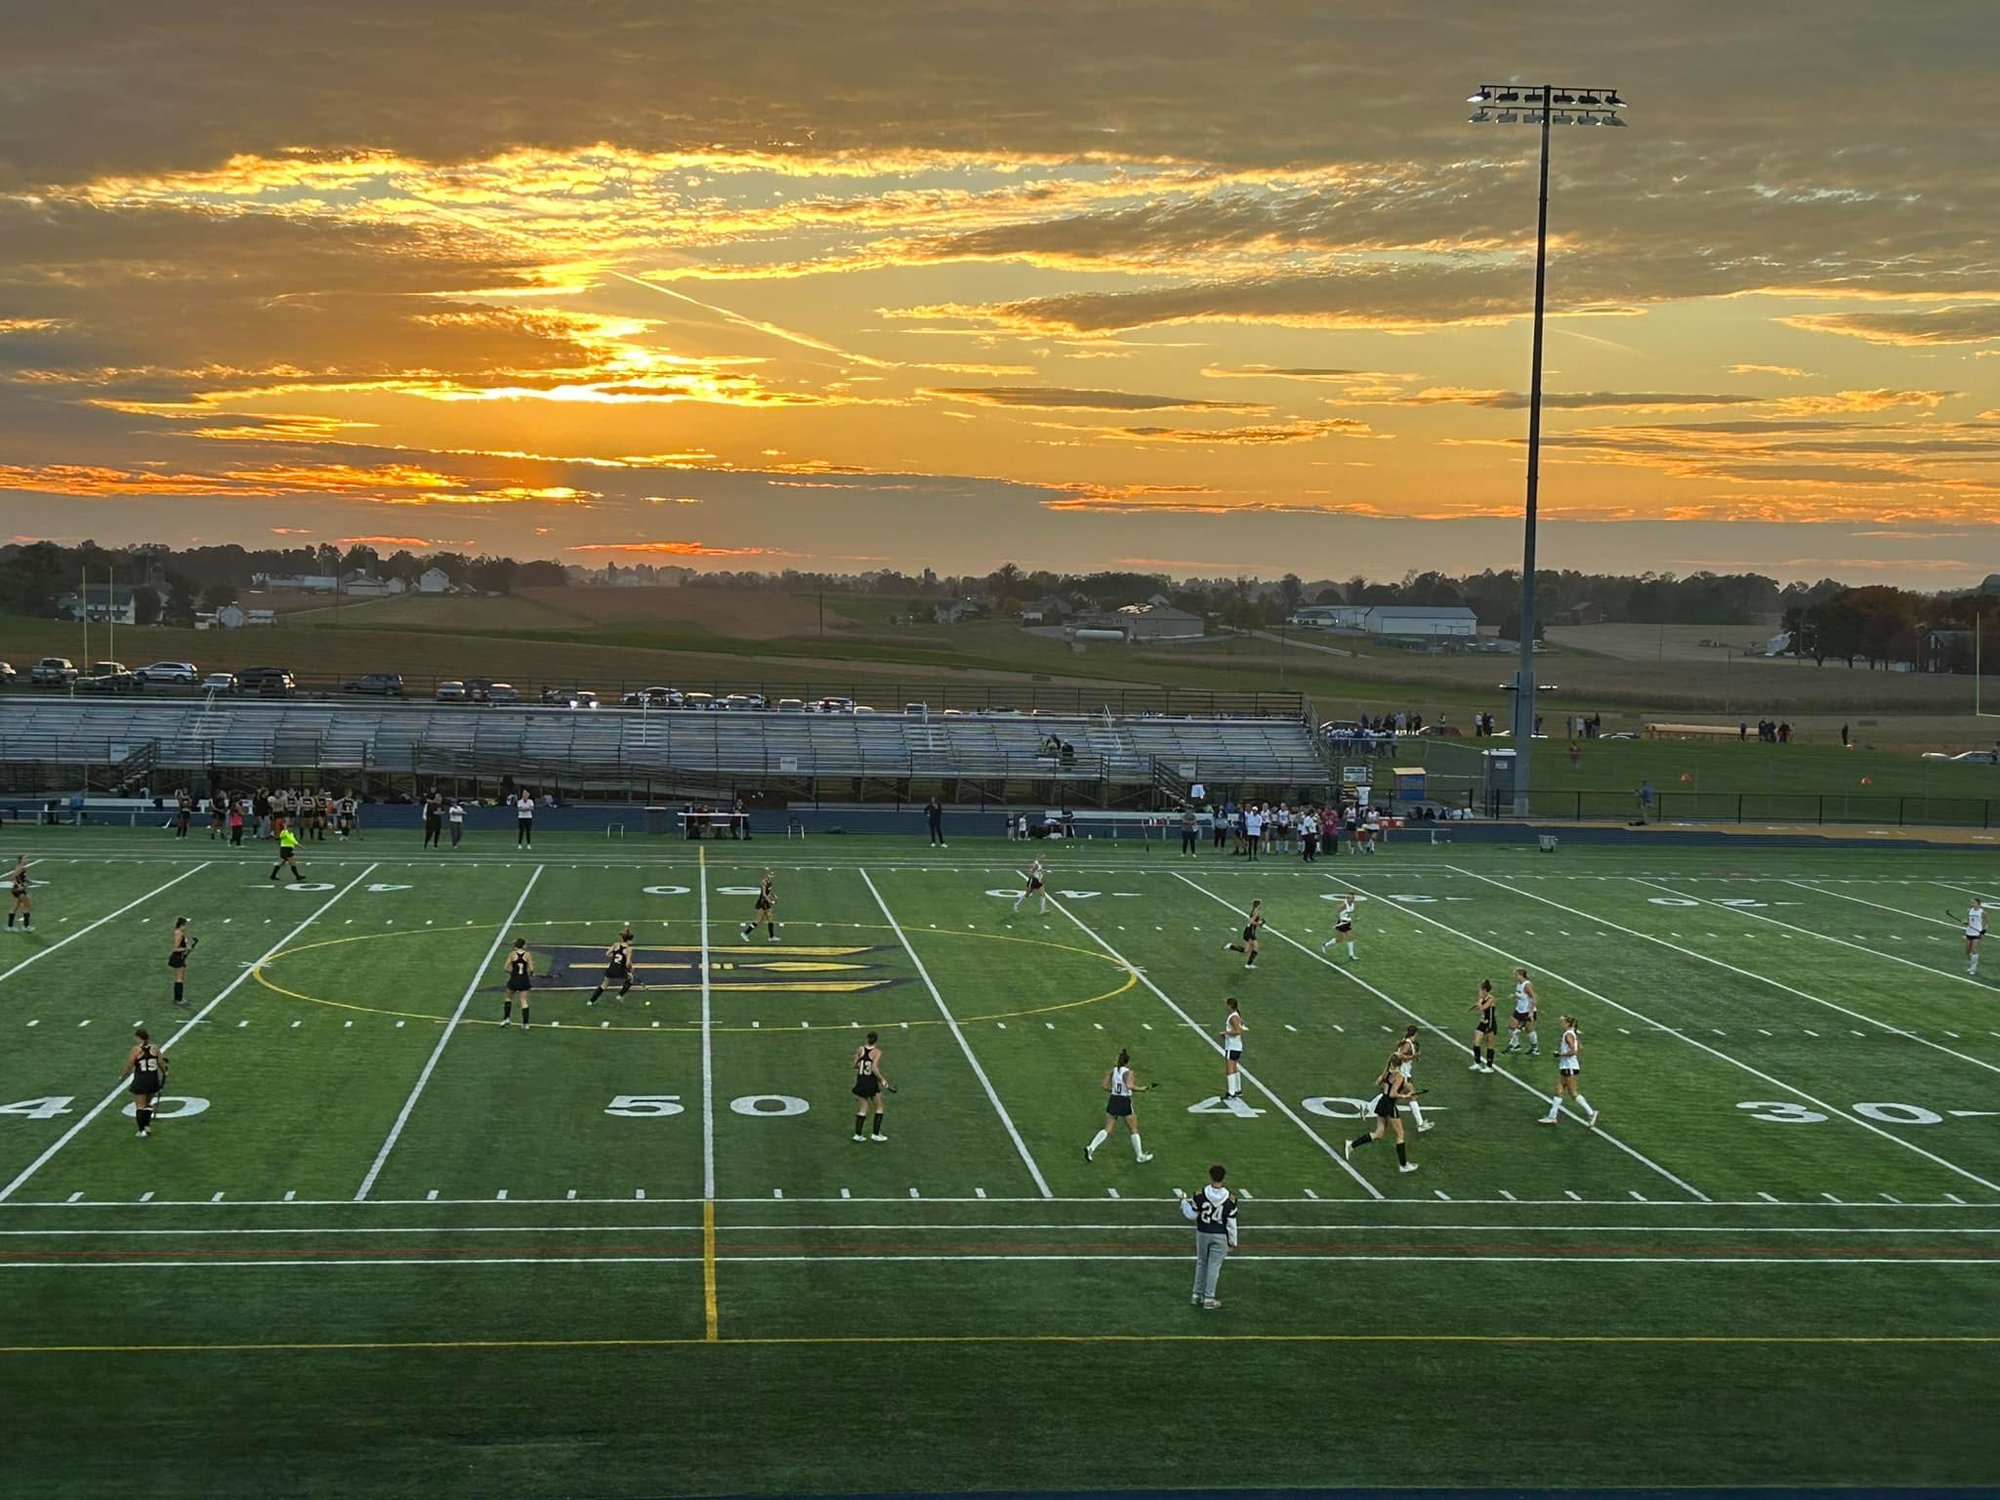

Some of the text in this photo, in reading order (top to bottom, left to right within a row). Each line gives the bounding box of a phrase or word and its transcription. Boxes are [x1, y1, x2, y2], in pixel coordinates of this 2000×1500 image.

[614, 953, 623, 964] 2
[517, 962, 524, 975] 1
[858, 1060, 872, 1076] 13
[1201, 1201, 1224, 1224] 24
